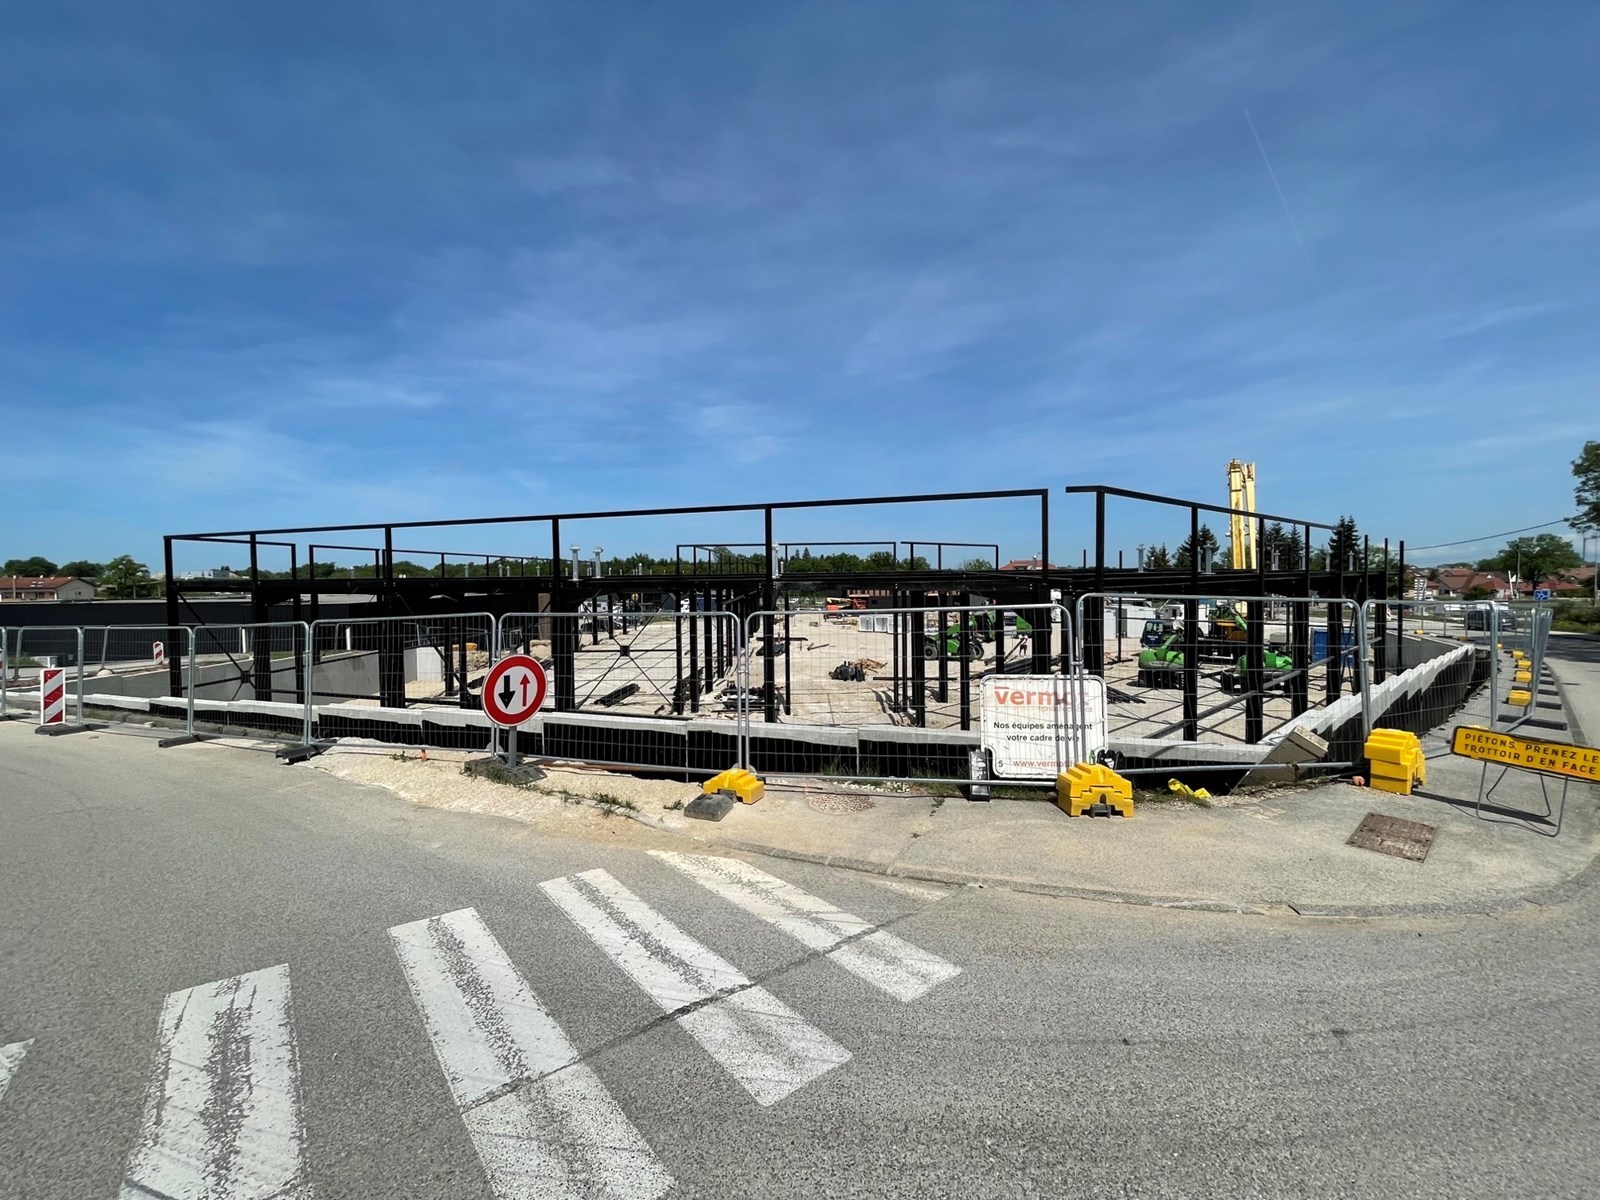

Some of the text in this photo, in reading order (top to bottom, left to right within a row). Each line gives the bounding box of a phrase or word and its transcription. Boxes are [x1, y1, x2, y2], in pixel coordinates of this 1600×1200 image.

[994, 721, 1010, 730] Nos
[1012, 721, 1045, 731] équipes
[1006, 734, 1027, 742] votre
[1029, 734, 1053, 742] cadre
[1055, 734, 1065, 742] de
[1464, 743, 1521, 761] TROTTOIR
[1562, 761, 1597, 775] FACE
[1525, 743, 1578, 759] PRENEZ
[1583, 753, 1599, 764] LE
